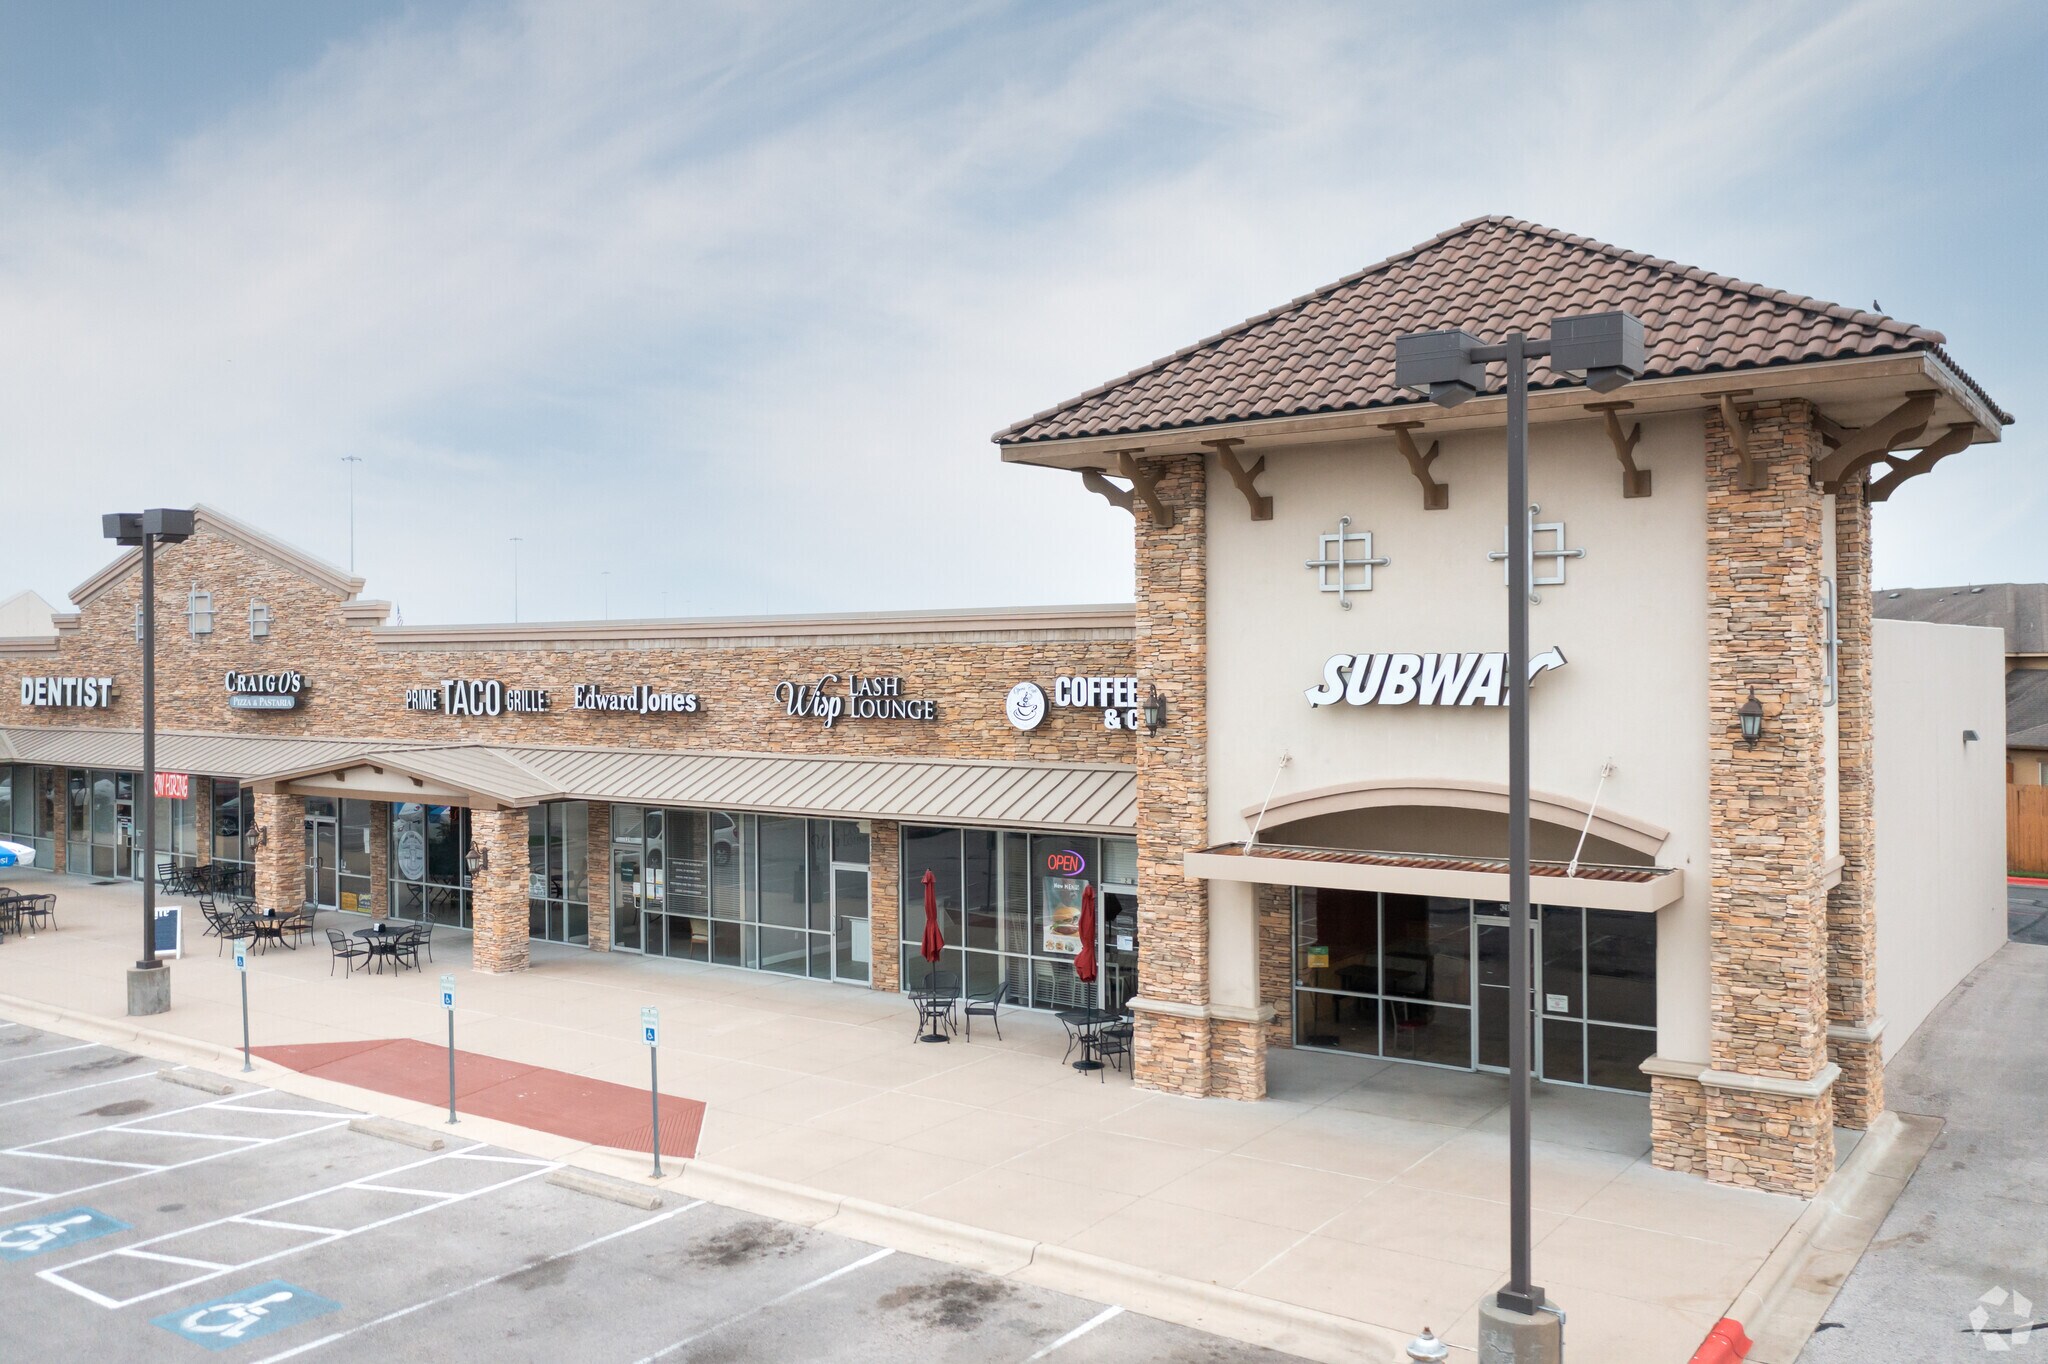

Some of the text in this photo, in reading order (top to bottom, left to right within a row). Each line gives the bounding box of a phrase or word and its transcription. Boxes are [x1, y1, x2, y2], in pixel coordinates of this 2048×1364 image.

[21, 676, 112, 708] DENTIST
[405, 680, 545, 716] PRIME TACO GRILLE
[849, 674, 899, 697] LASH
[1055, 676, 1138, 708] COFFEE
[233, 697, 251, 706] PIZZA
[573, 684, 697, 714] Edward Jones
[774, 673, 842, 729] Wisp
[850, 697, 934, 720] LOUNGE
[1104, 708, 1121, 730] &
[1047, 854, 1079, 871] OPEN
